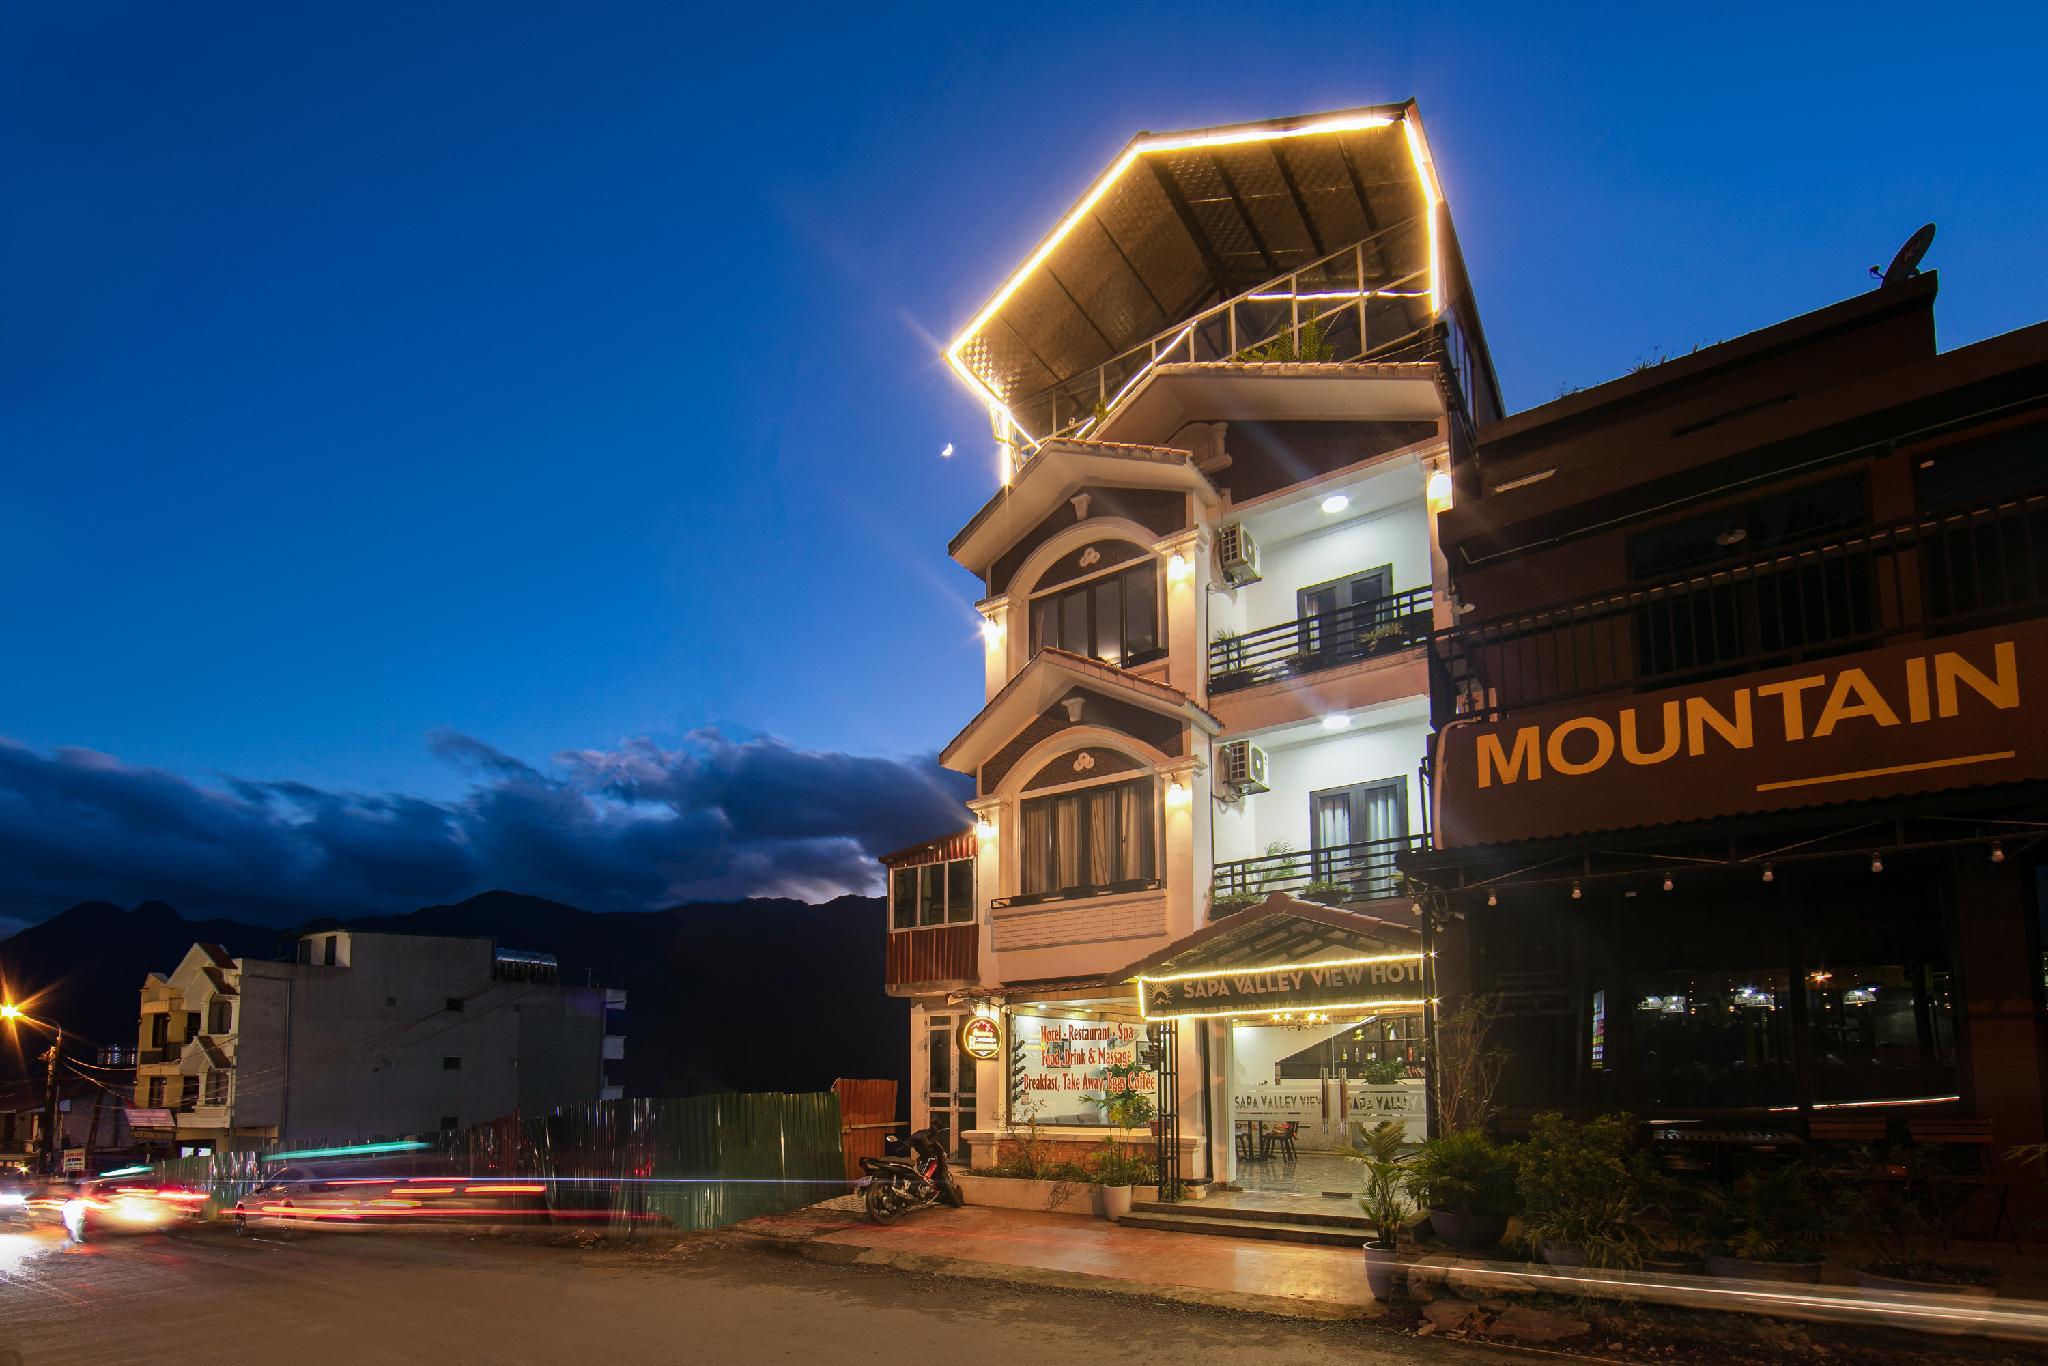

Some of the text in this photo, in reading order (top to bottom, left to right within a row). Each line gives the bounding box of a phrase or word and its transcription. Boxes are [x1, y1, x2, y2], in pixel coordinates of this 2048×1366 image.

[1476, 641, 2020, 788] MOUNTAIN
[1183, 978, 1231, 998] SAPA
[1234, 970, 1304, 995] VALLEY
[1310, 965, 1364, 988] VIEW
[1041, 1024, 1061, 1042] Hotel
[1069, 1024, 1110, 1041] Restaurant
[1118, 1023, 1134, 1040] Spa
[1065, 1048, 1085, 1065] Drink
[1088, 1047, 1096, 1065] &
[1098, 1047, 1132, 1067] Massage
[1024, 1073, 1060, 1091] Breakfast,
[1063, 1073, 1080, 1090] Take
[1107, 1072, 1126, 1092] Eggs
[1128, 1071, 1155, 1090] Coffee
[1235, 1096, 1259, 1109] SAPA
[1261, 1096, 1297, 1109] VALLEY
